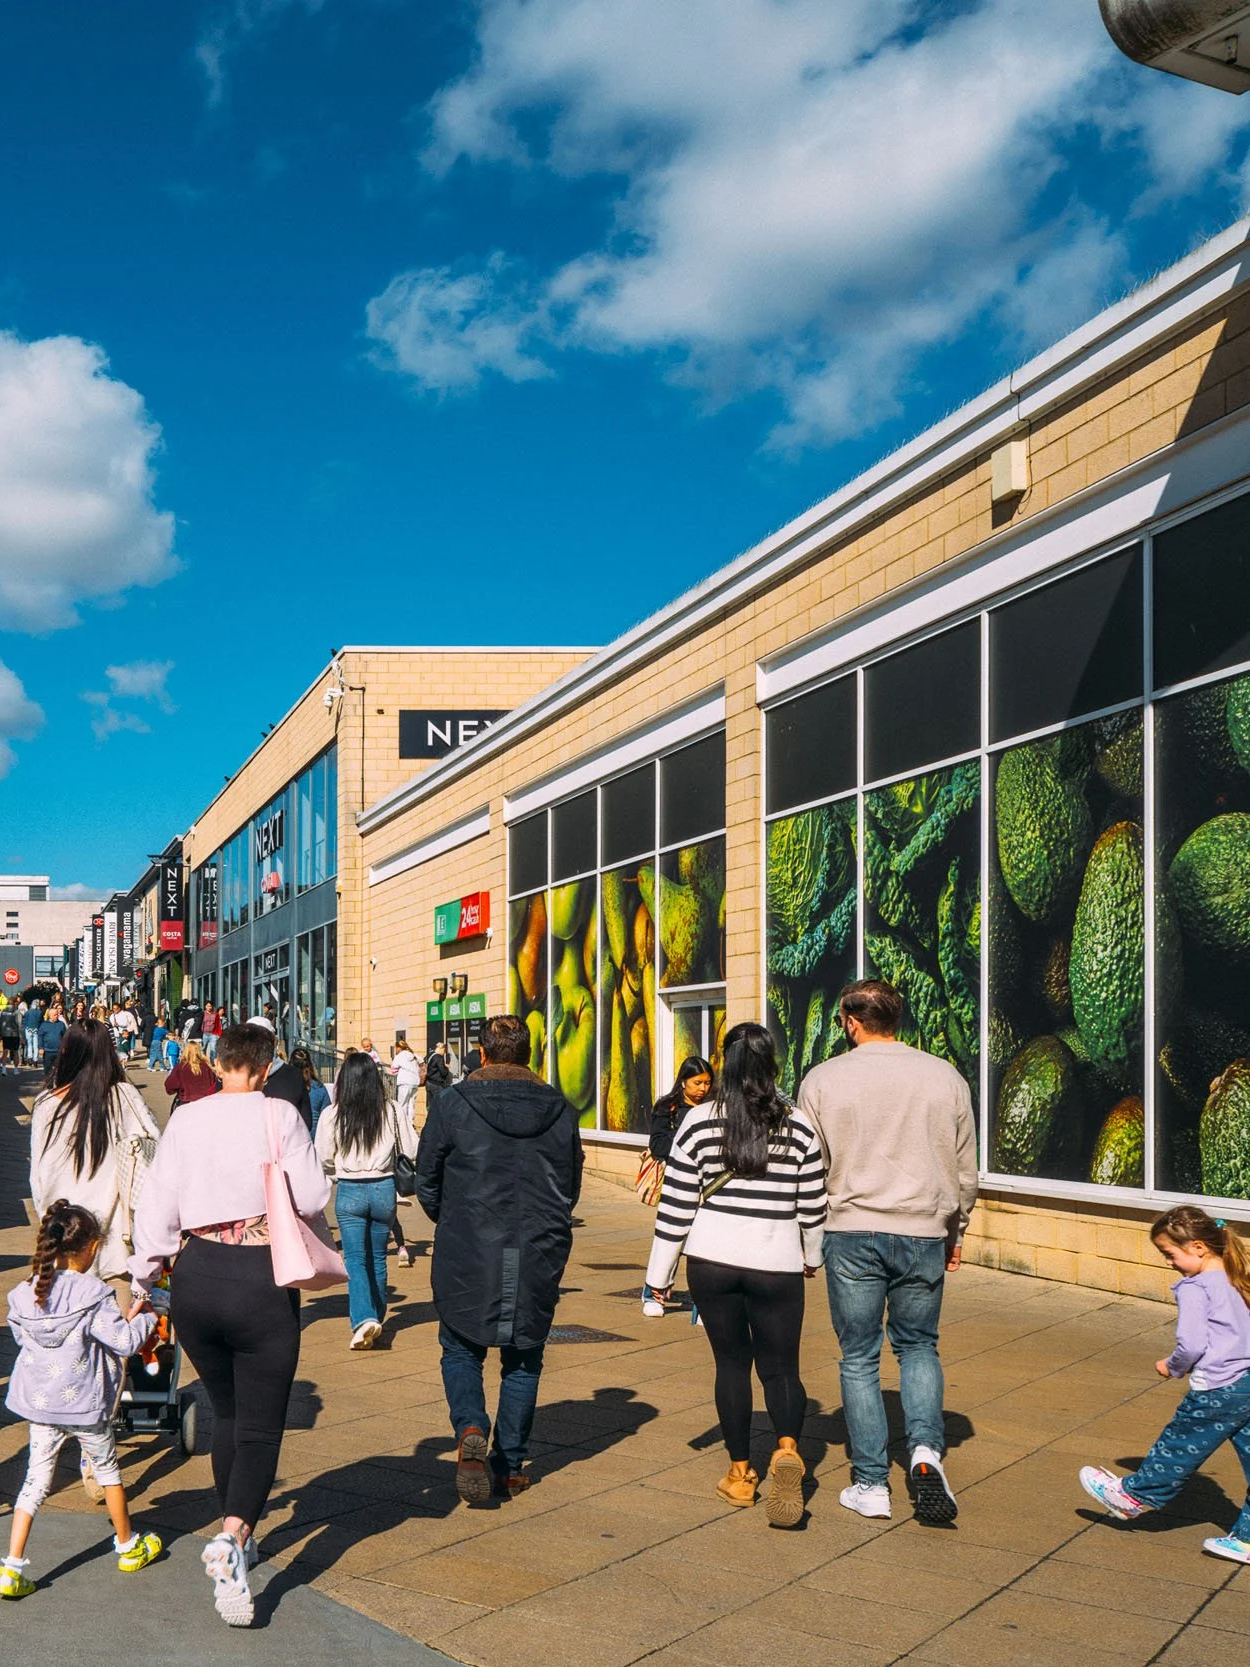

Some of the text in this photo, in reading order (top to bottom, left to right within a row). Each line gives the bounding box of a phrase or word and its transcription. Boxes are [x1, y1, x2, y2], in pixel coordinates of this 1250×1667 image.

[427, 720, 493, 746] NE
[256, 811, 282, 861] NEXT
[167, 868, 178, 917] NEXT
[265, 954, 276, 970] NEXT
